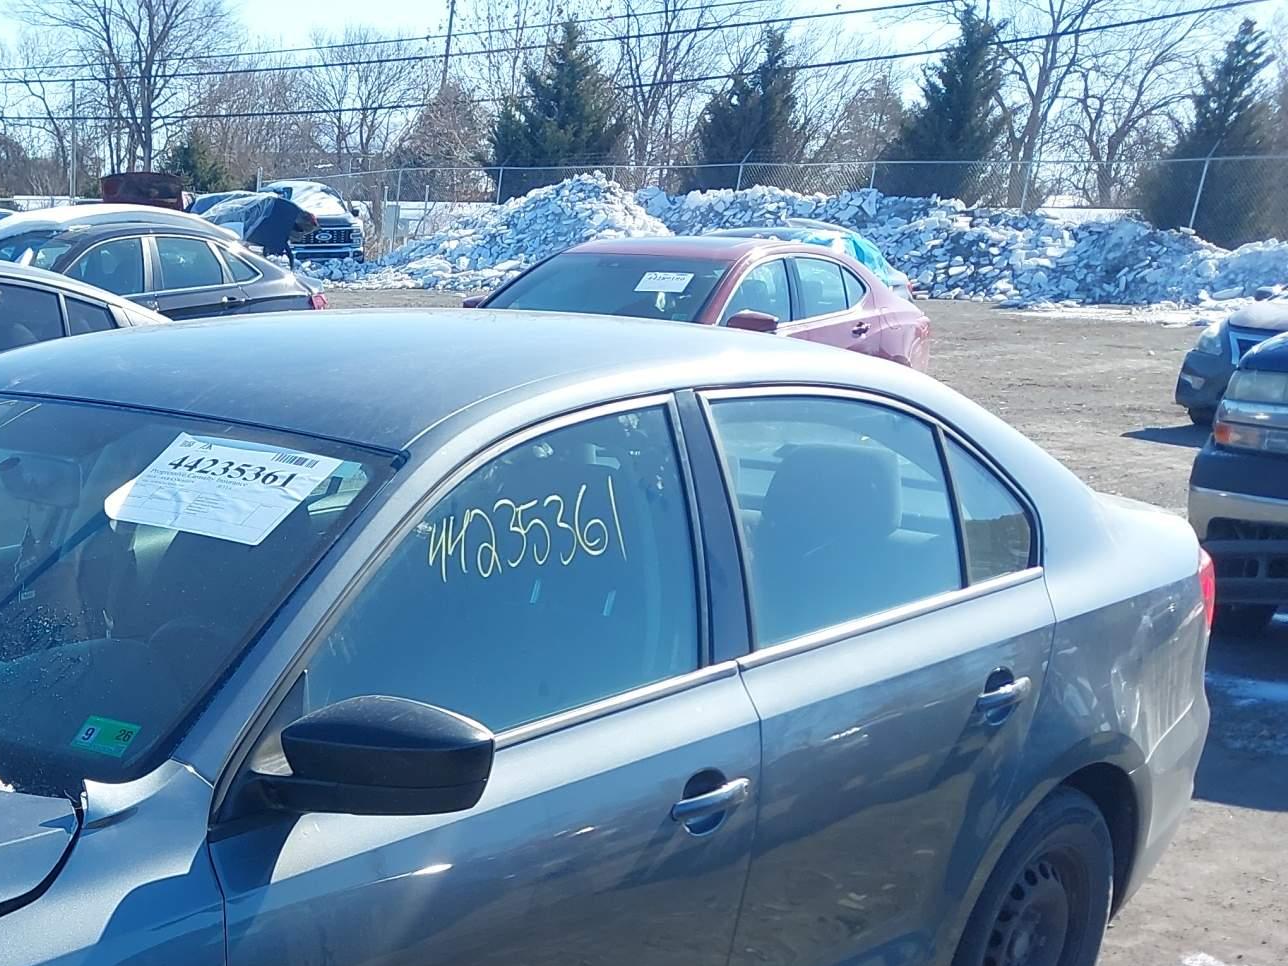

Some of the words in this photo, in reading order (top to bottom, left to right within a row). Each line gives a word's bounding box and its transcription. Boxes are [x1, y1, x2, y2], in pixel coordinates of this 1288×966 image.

[168, 454, 298, 488] 44235361
[428, 475, 627, 583] 44235361
[82, 727, 96, 741] 9
[115, 729, 134, 743] 26
